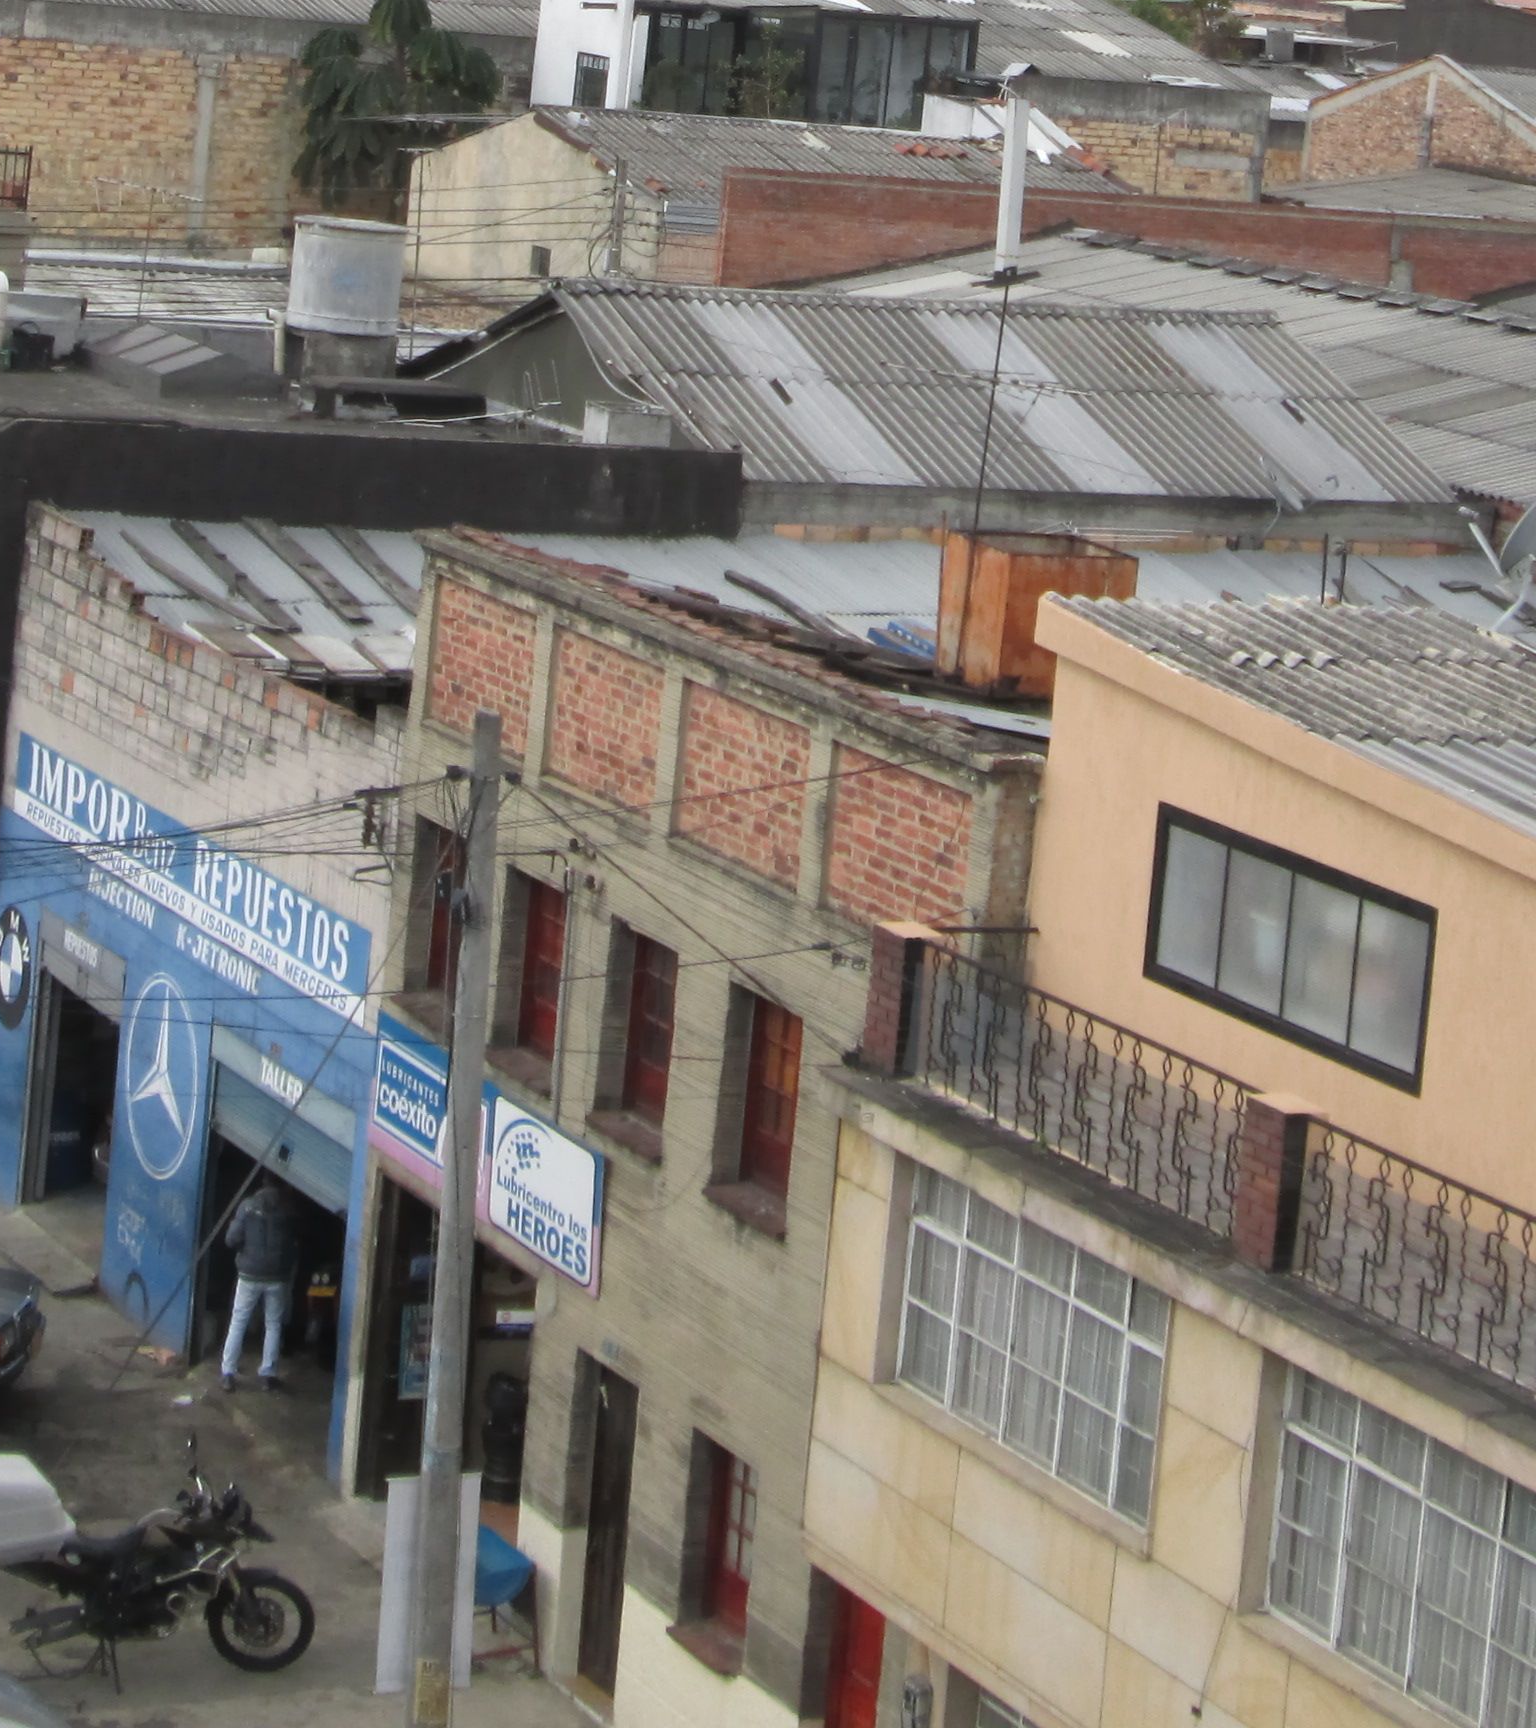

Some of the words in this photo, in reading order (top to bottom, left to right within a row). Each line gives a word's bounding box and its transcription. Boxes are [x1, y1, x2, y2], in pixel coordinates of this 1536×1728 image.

[29, 742, 131, 846] IMPOR
[193, 839, 350, 983] REPUESTOS
[88, 867, 156, 930] INJECTION
[26, 801, 81, 843] REPUESTOS
[144, 875, 186, 912] NUEVOS
[201, 908, 247, 948] USADOS
[251, 938, 280, 972] PARA
[283, 959, 349, 1013] MERCEDES
[380, 1083, 437, 1140] coéxito
[381, 1058, 440, 1109] LUBRICANTES
[496, 1165, 565, 1227] Lubricentro
[569, 1213, 588, 1242] los
[507, 1198, 587, 1277] HEROES
